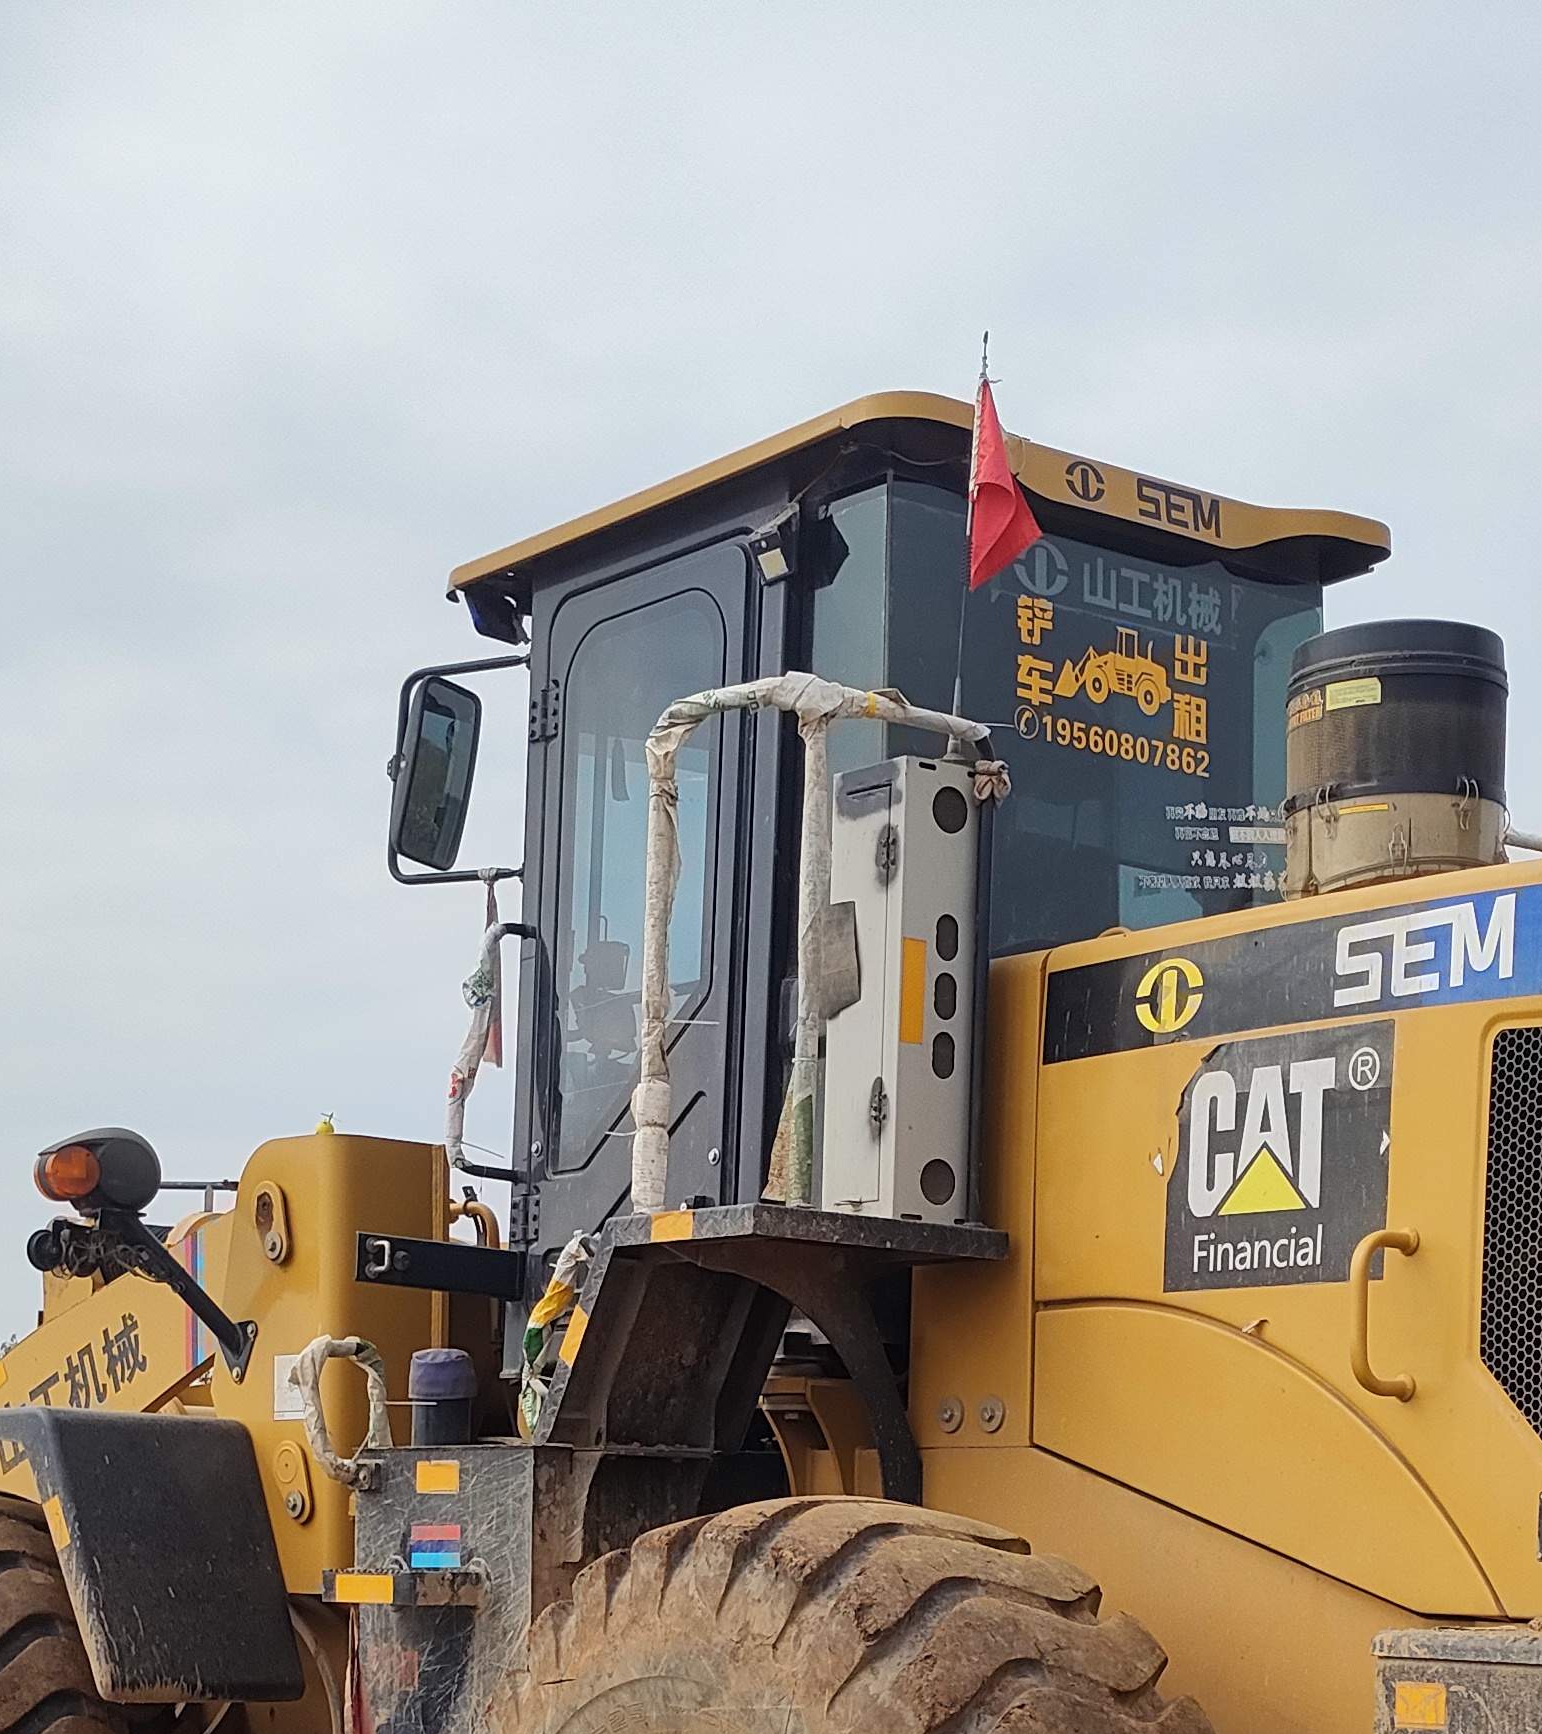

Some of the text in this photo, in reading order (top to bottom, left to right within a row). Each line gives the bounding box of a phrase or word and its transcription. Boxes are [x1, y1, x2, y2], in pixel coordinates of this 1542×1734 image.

[1136, 476, 1222, 539] SEM
[1082, 556, 1222, 636] 山工机械
[1042, 714, 1210, 778] 19560807862
[1333, 892, 1517, 1008] SEM
[1187, 1056, 1336, 1219] CAT
[1191, 1223, 1323, 1274] Financial
